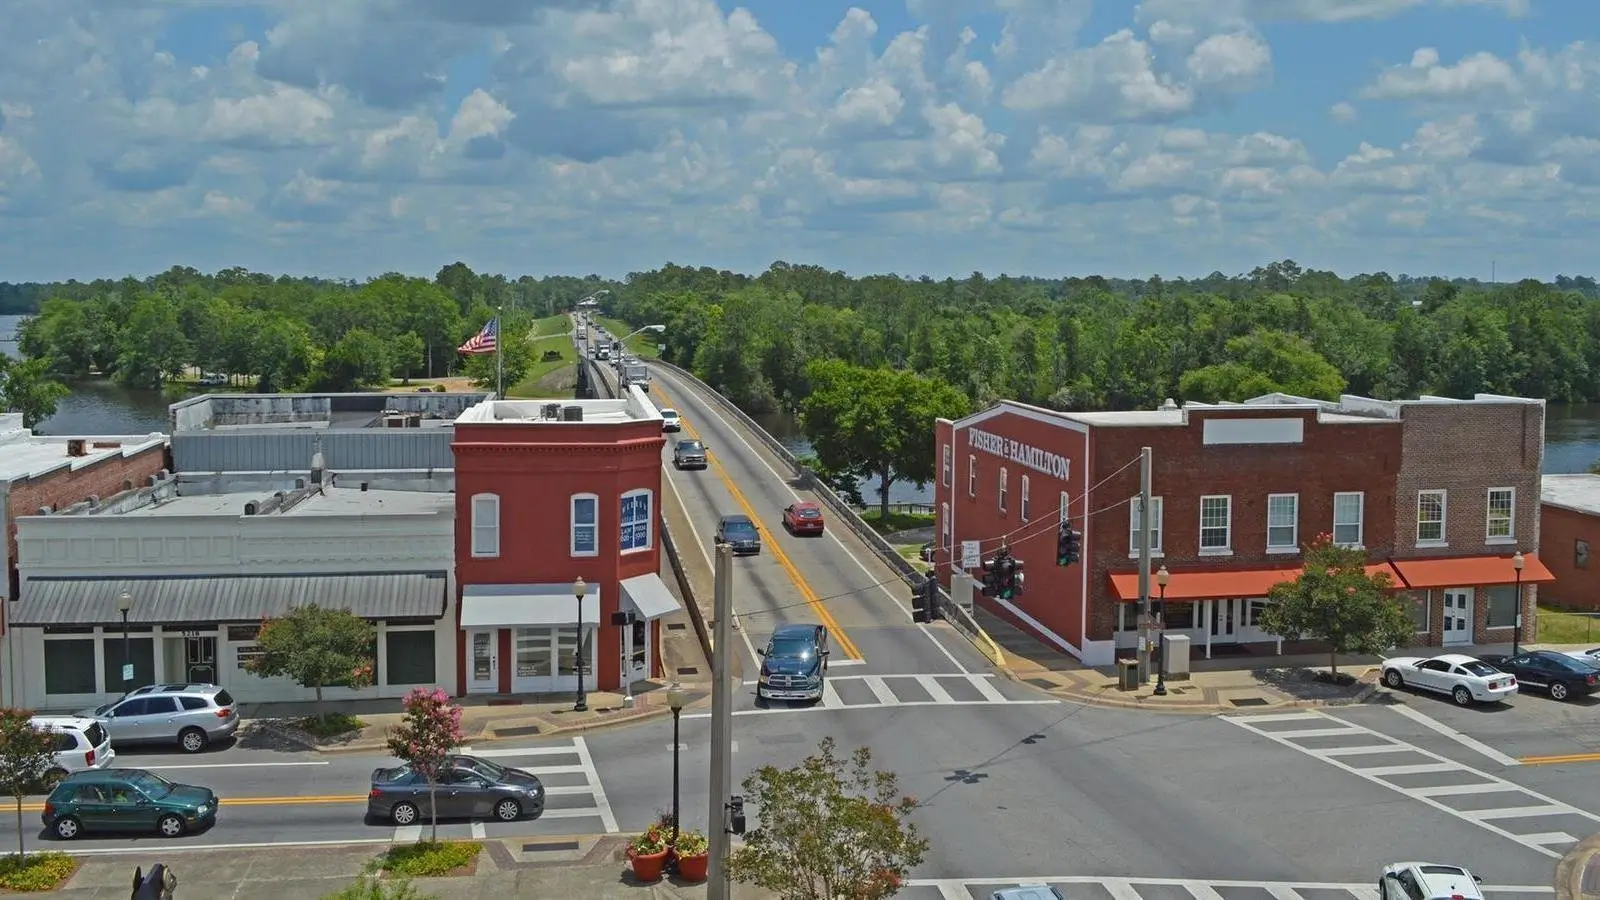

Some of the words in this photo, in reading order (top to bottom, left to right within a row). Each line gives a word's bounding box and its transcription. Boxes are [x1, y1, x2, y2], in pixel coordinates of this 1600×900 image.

[968, 427, 1003, 457] FISHER
[1004, 438, 1009, 458] &
[1009, 440, 1071, 481] HAMILTON
